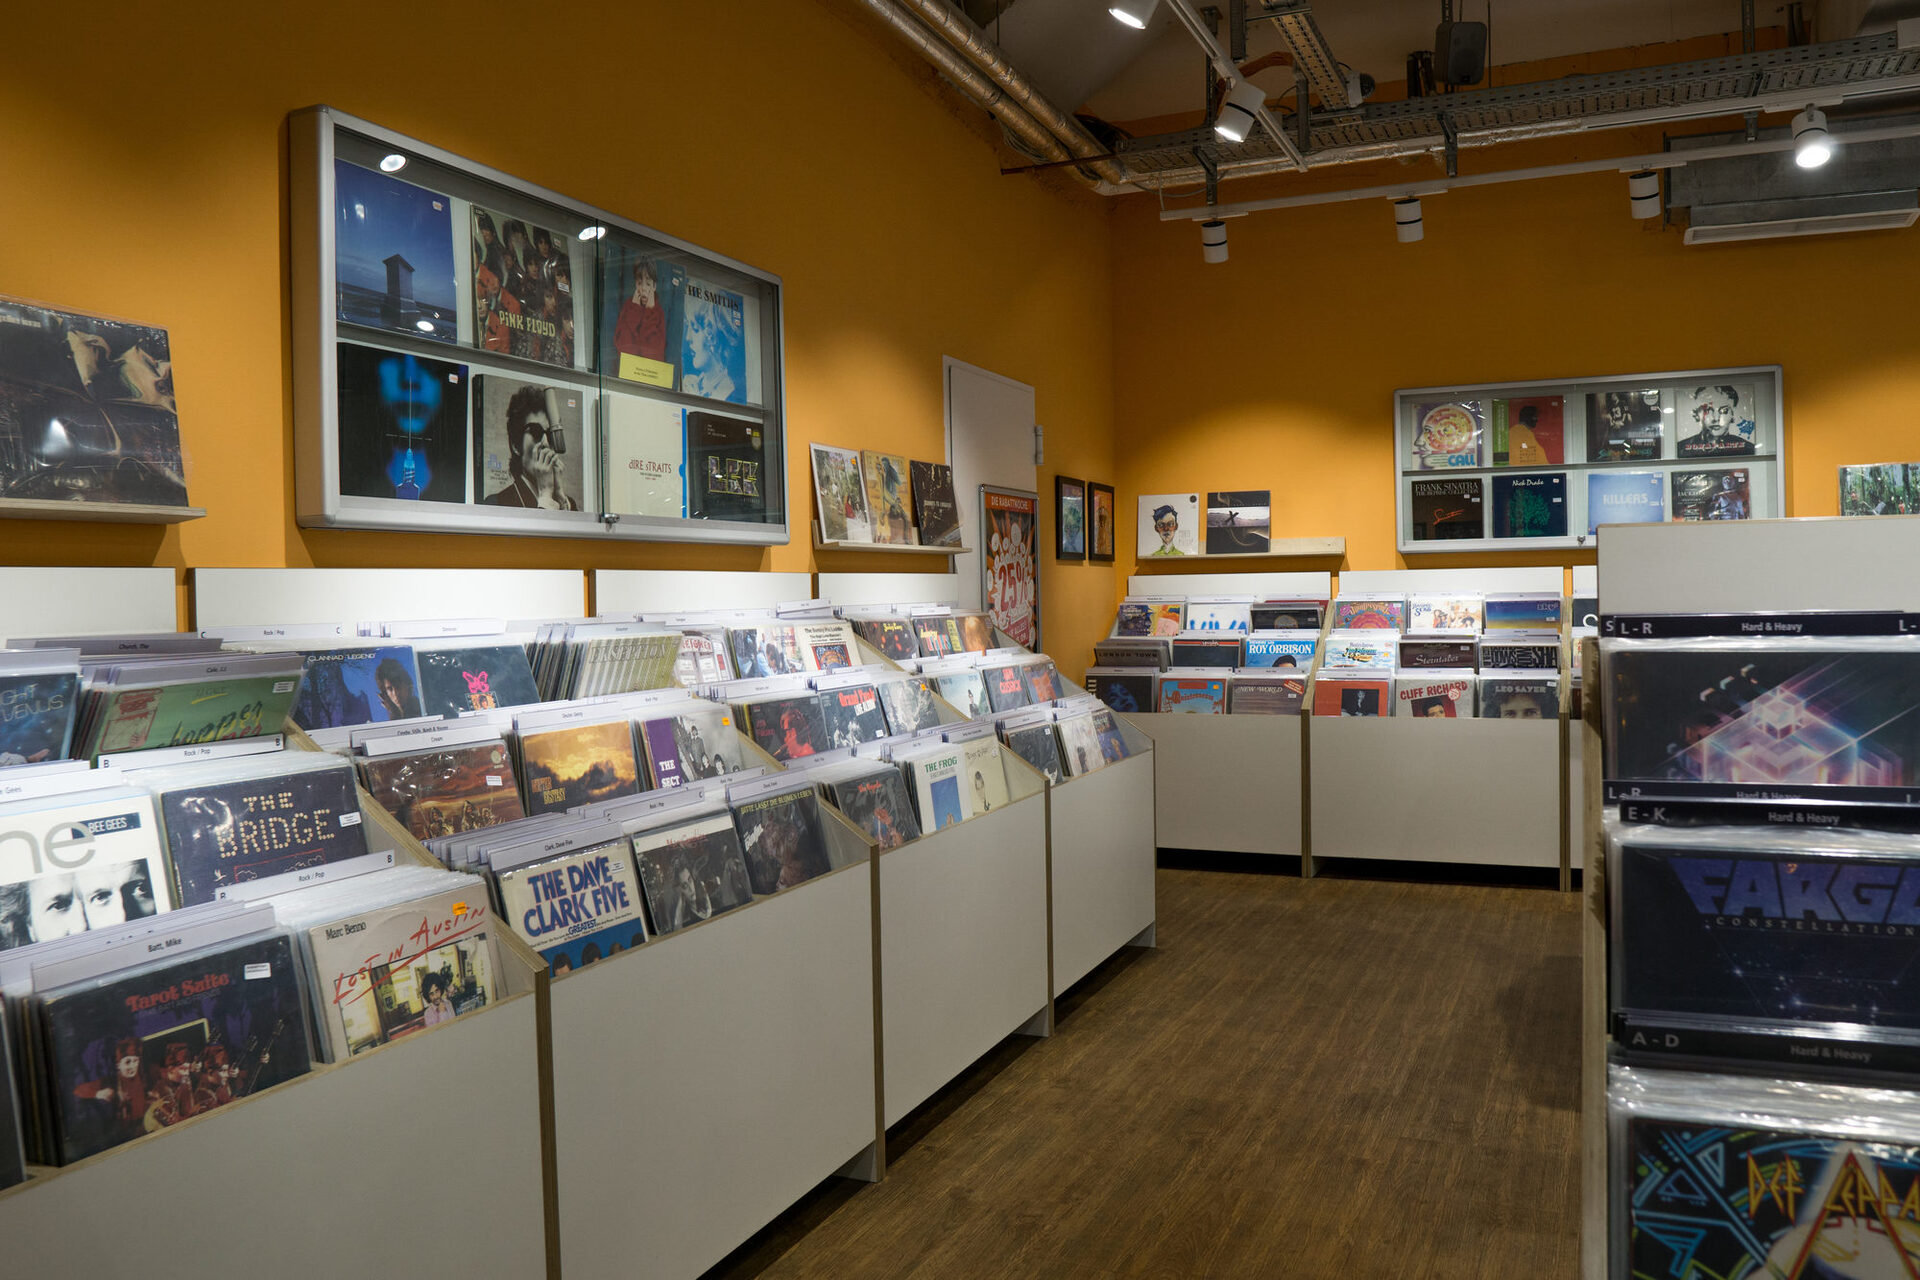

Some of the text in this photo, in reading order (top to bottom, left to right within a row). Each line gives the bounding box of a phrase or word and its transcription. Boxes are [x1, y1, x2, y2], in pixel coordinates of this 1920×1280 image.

[704, 290, 739, 311] SMITHS
[526, 317, 556, 337] FLOYD
[1415, 481, 1479, 492] FRANK SINATRA
[1621, 623, 1630, 635] L
[1642, 623, 1653, 635] R
[1742, 621, 1802, 632] Hard & Heavy
[1248, 643, 1312, 654] ROY ORBISON
[307, 654, 344, 662] CLANNAD
[1400, 680, 1468, 700] CLIFF RICHARD
[1514, 685, 1546, 693] SAYER
[3, 694, 64, 722] VENUS
[659, 759, 676, 771] THE
[925, 756, 957, 773] THE FROG
[661, 776, 681, 788] SECT
[243, 791, 293, 812] THE
[797, 789, 813, 799] LEBEN
[1628, 808, 1638, 820] E
[1654, 808, 1665, 820] K
[1768, 812, 1840, 825] Hard & Heavy
[87, 817, 128, 834] BEE GEES
[216, 807, 336, 859] BRIDGE
[299, 873, 313, 882] Rock
[316, 871, 325, 879] Pop
[528, 856, 613, 904] THE DAVE
[1667, 856, 1920, 926] FARG
[523, 888, 593, 937] CLARK
[592, 881, 630, 914] FIVE
[326, 921, 367, 941] Marc Benno
[567, 919, 597, 936] GREATEST
[165, 937, 182, 947] Mike
[387, 944, 403, 965] IN
[125, 985, 179, 1012] Tarot
[181, 973, 230, 997] Suite
[1632, 1031, 1645, 1045] A
[1665, 1034, 1680, 1047] D
[1790, 1045, 1872, 1062] Hard & Heavy
[1747, 1151, 1805, 1225] DEF
[1823, 1160, 1920, 1227] LEPPA
